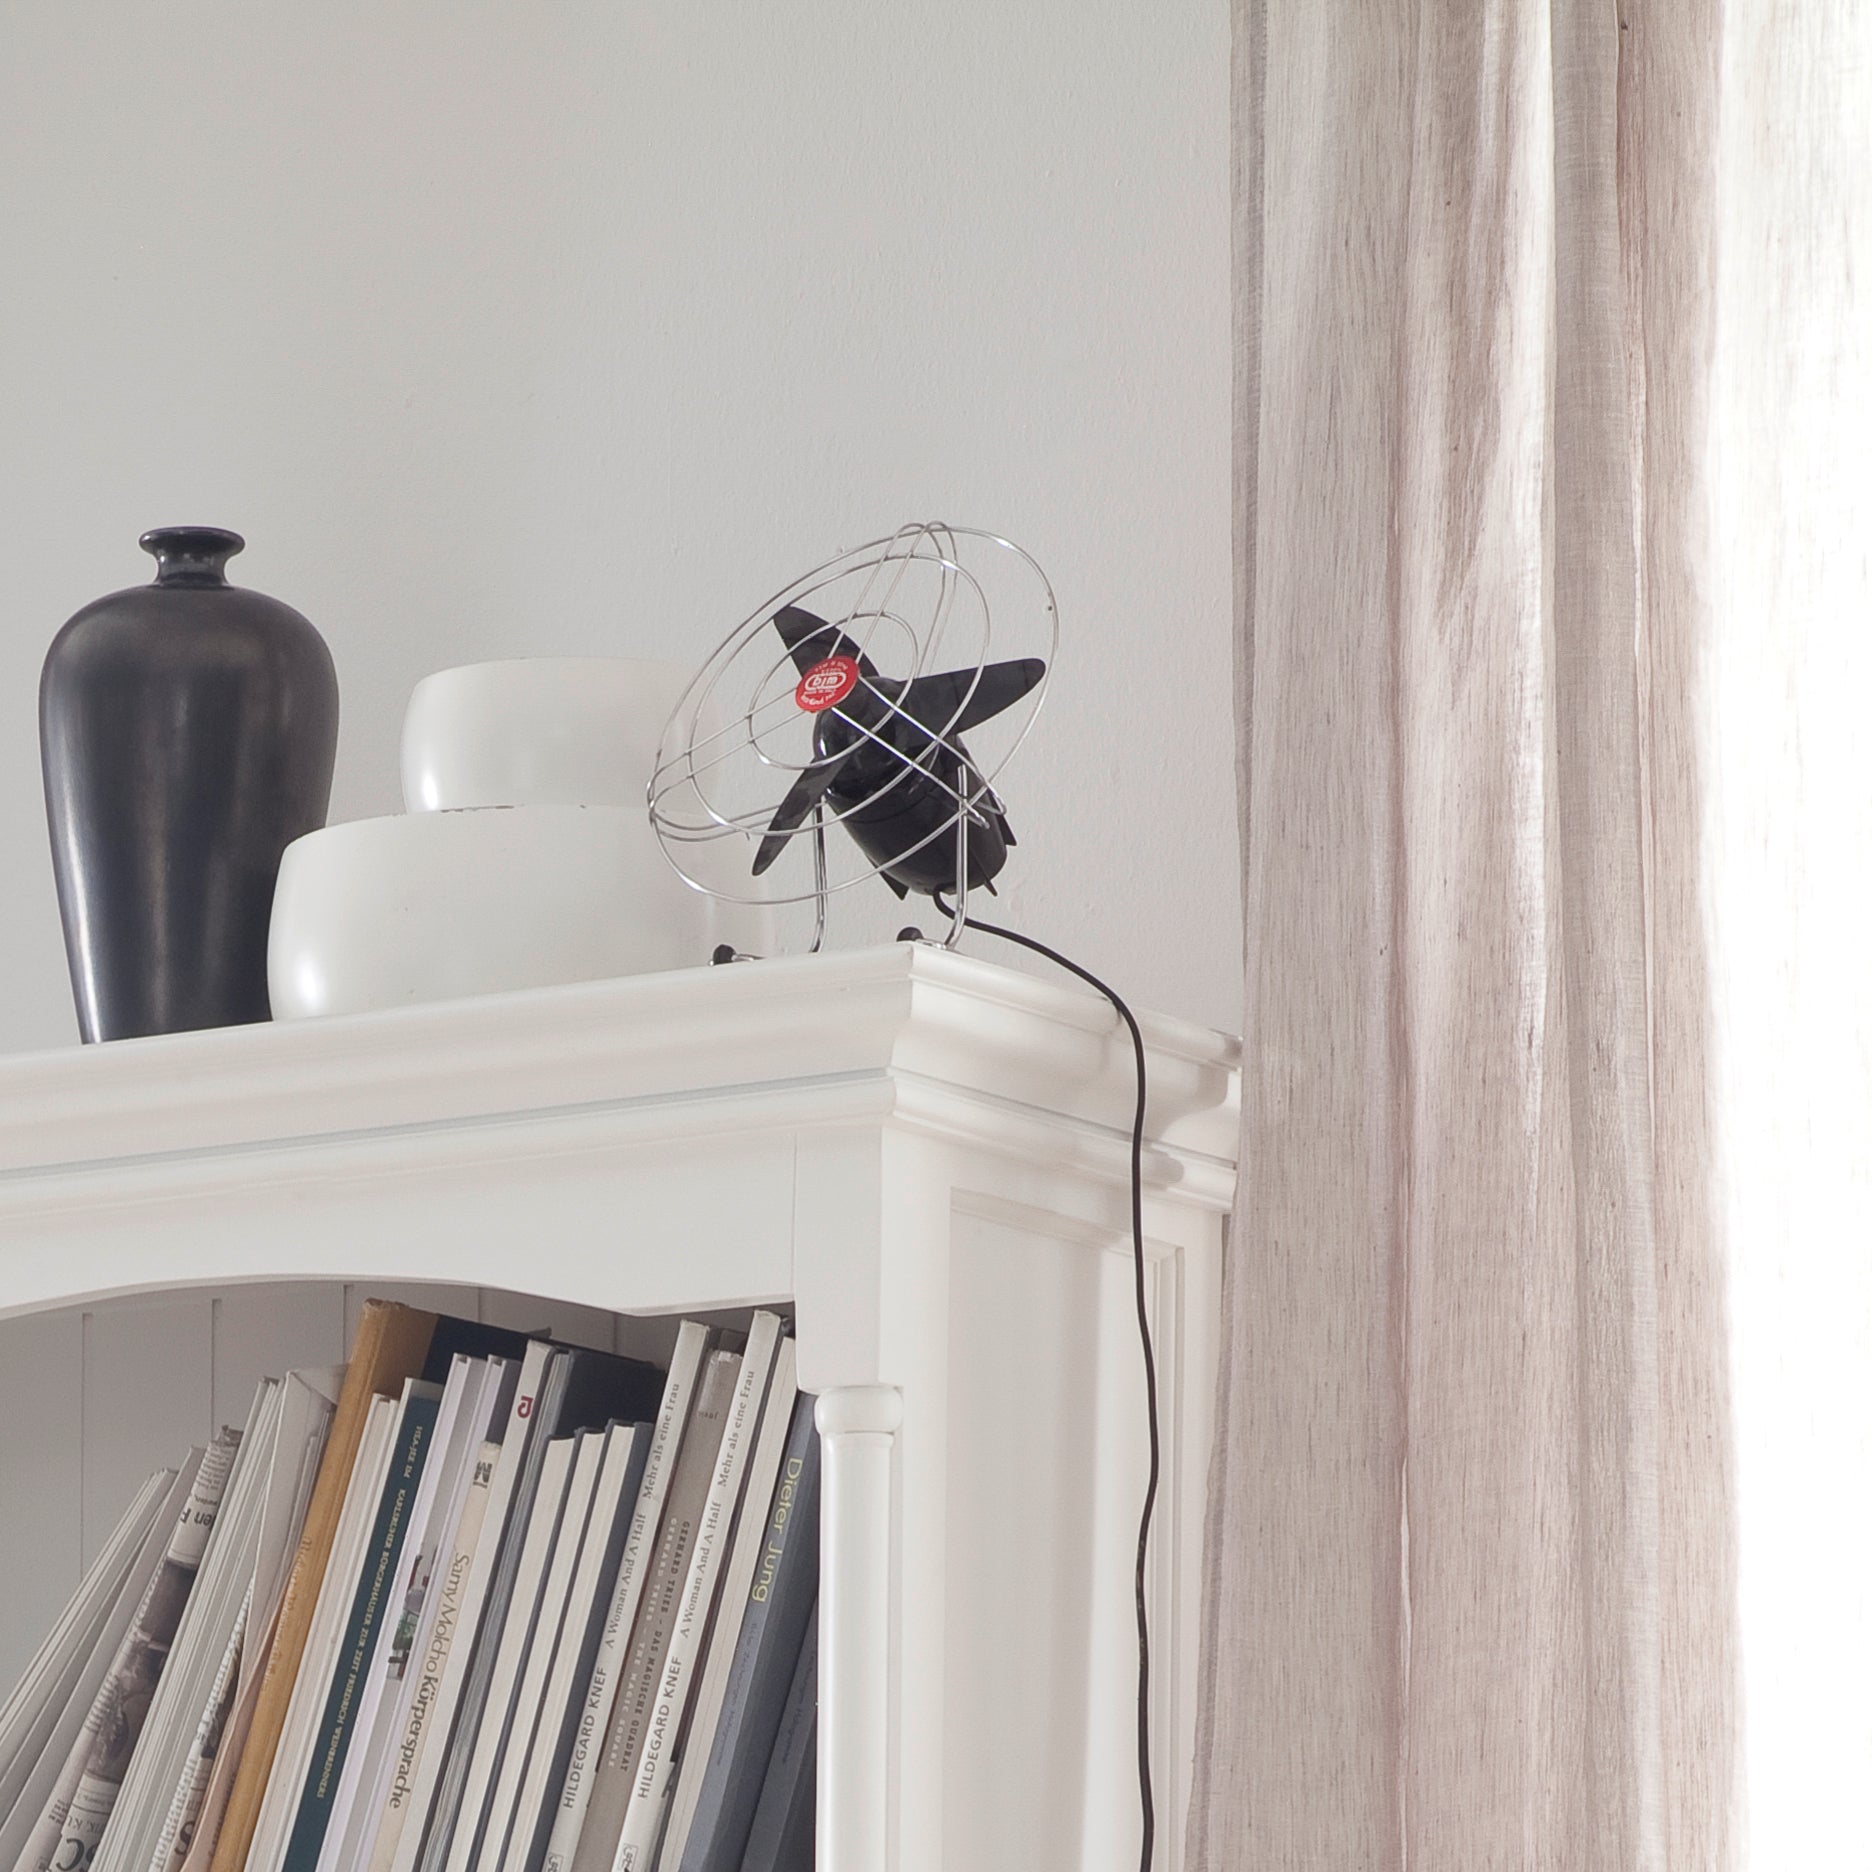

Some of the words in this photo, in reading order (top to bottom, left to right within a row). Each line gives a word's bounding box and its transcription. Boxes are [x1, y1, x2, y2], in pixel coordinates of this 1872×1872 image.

[665, 1382, 680, 1411] Frau
[739, 1369, 756, 1399] Frau
[658, 1414, 673, 1441] eine
[732, 1401, 747, 1429] eine
[651, 1442, 665, 1462] als
[725, 1430, 740, 1450] als
[641, 1464, 660, 1499] Mehr
[716, 1451, 735, 1487] Mehr
[767, 1455, 806, 1535] Dieter
[630, 1511, 647, 1541] Half
[705, 1500, 723, 1530] Half
[626, 1543, 639, 1555] A
[702, 1532, 714, 1544] A
[619, 1557, 636, 1585] And
[694, 1546, 711, 1573] And
[748, 1539, 784, 1603] Jung
[441, 1550, 470, 1603] Samy
[606, 1586, 629, 1636] Woman
[681, 1575, 704, 1624] Woman
[357, 1627, 369, 1648] ZUR
[424, 1603, 457, 1674] Molcho
[603, 1637, 615, 1649] A
[678, 1625, 690, 1638] A
[350, 1649, 363, 1670] ZEIT
[385, 1672, 439, 1810] Körpersprache
[560, 1713, 598, 1809] HILDEGARD
[586, 1666, 609, 1709] KNEF
[634, 1703, 672, 1799] HILDEGARD
[661, 1654, 683, 1699] KNEF
